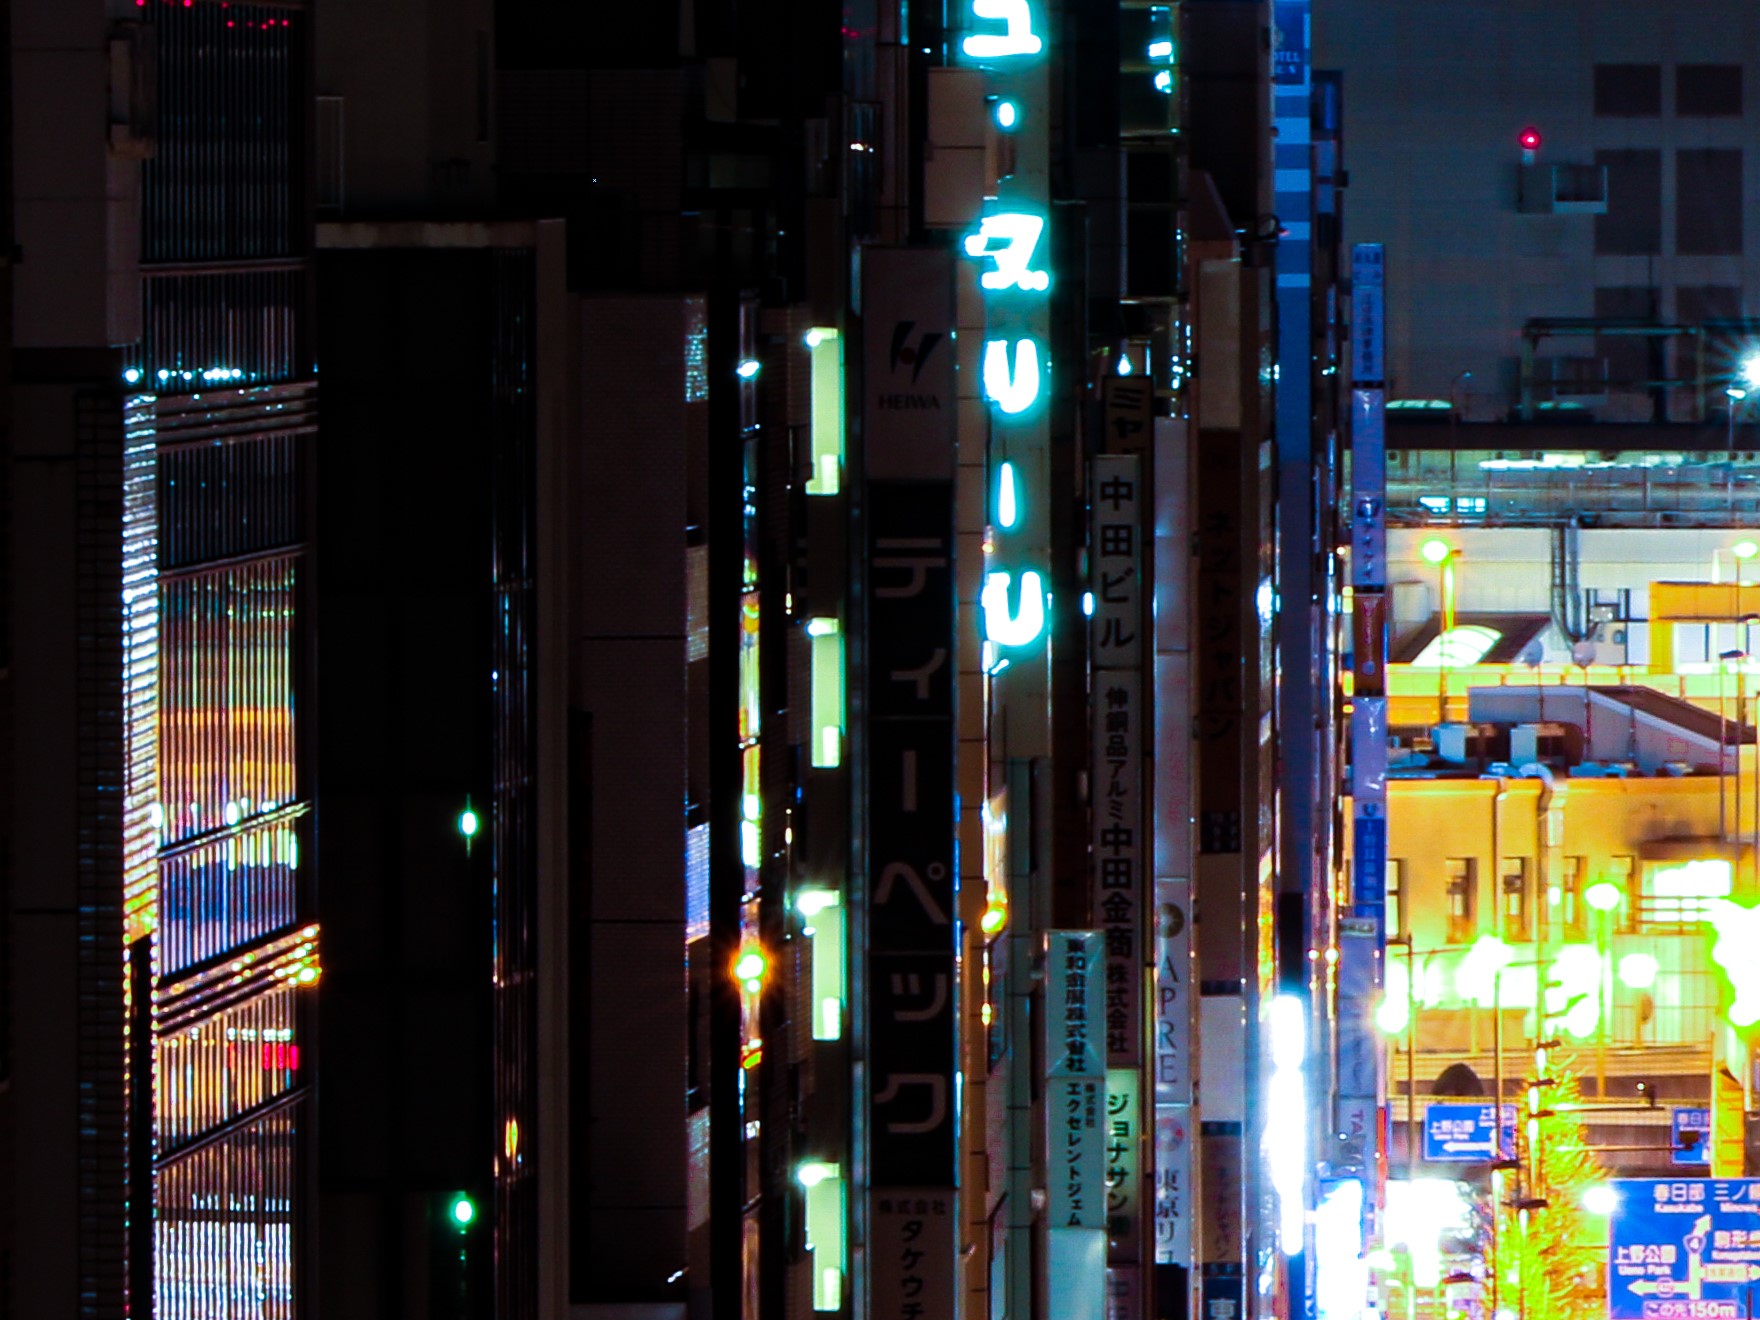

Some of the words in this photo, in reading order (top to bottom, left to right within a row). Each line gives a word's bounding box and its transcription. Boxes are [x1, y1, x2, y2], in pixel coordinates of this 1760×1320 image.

[879, 395, 940, 410] HEIWA
[1110, 387, 1146, 453] ミヤ
[1101, 475, 1134, 647] 中田ビル
[1206, 510, 1232, 739] ネットジャパン
[873, 536, 950, 1136] ティーペック
[1106, 964, 1128, 1053] 株式会社
[1066, 1082, 1083, 1226] エクセレントジェム
[1106, 1093, 1129, 1212] ジョナサン
[1653, 1182, 1706, 1202] 春日部
[1614, 1245, 1677, 1265] 上野公園
[1617, 1265, 1645, 1276] Ueno
[1647, 1265, 1672, 1276] Park
